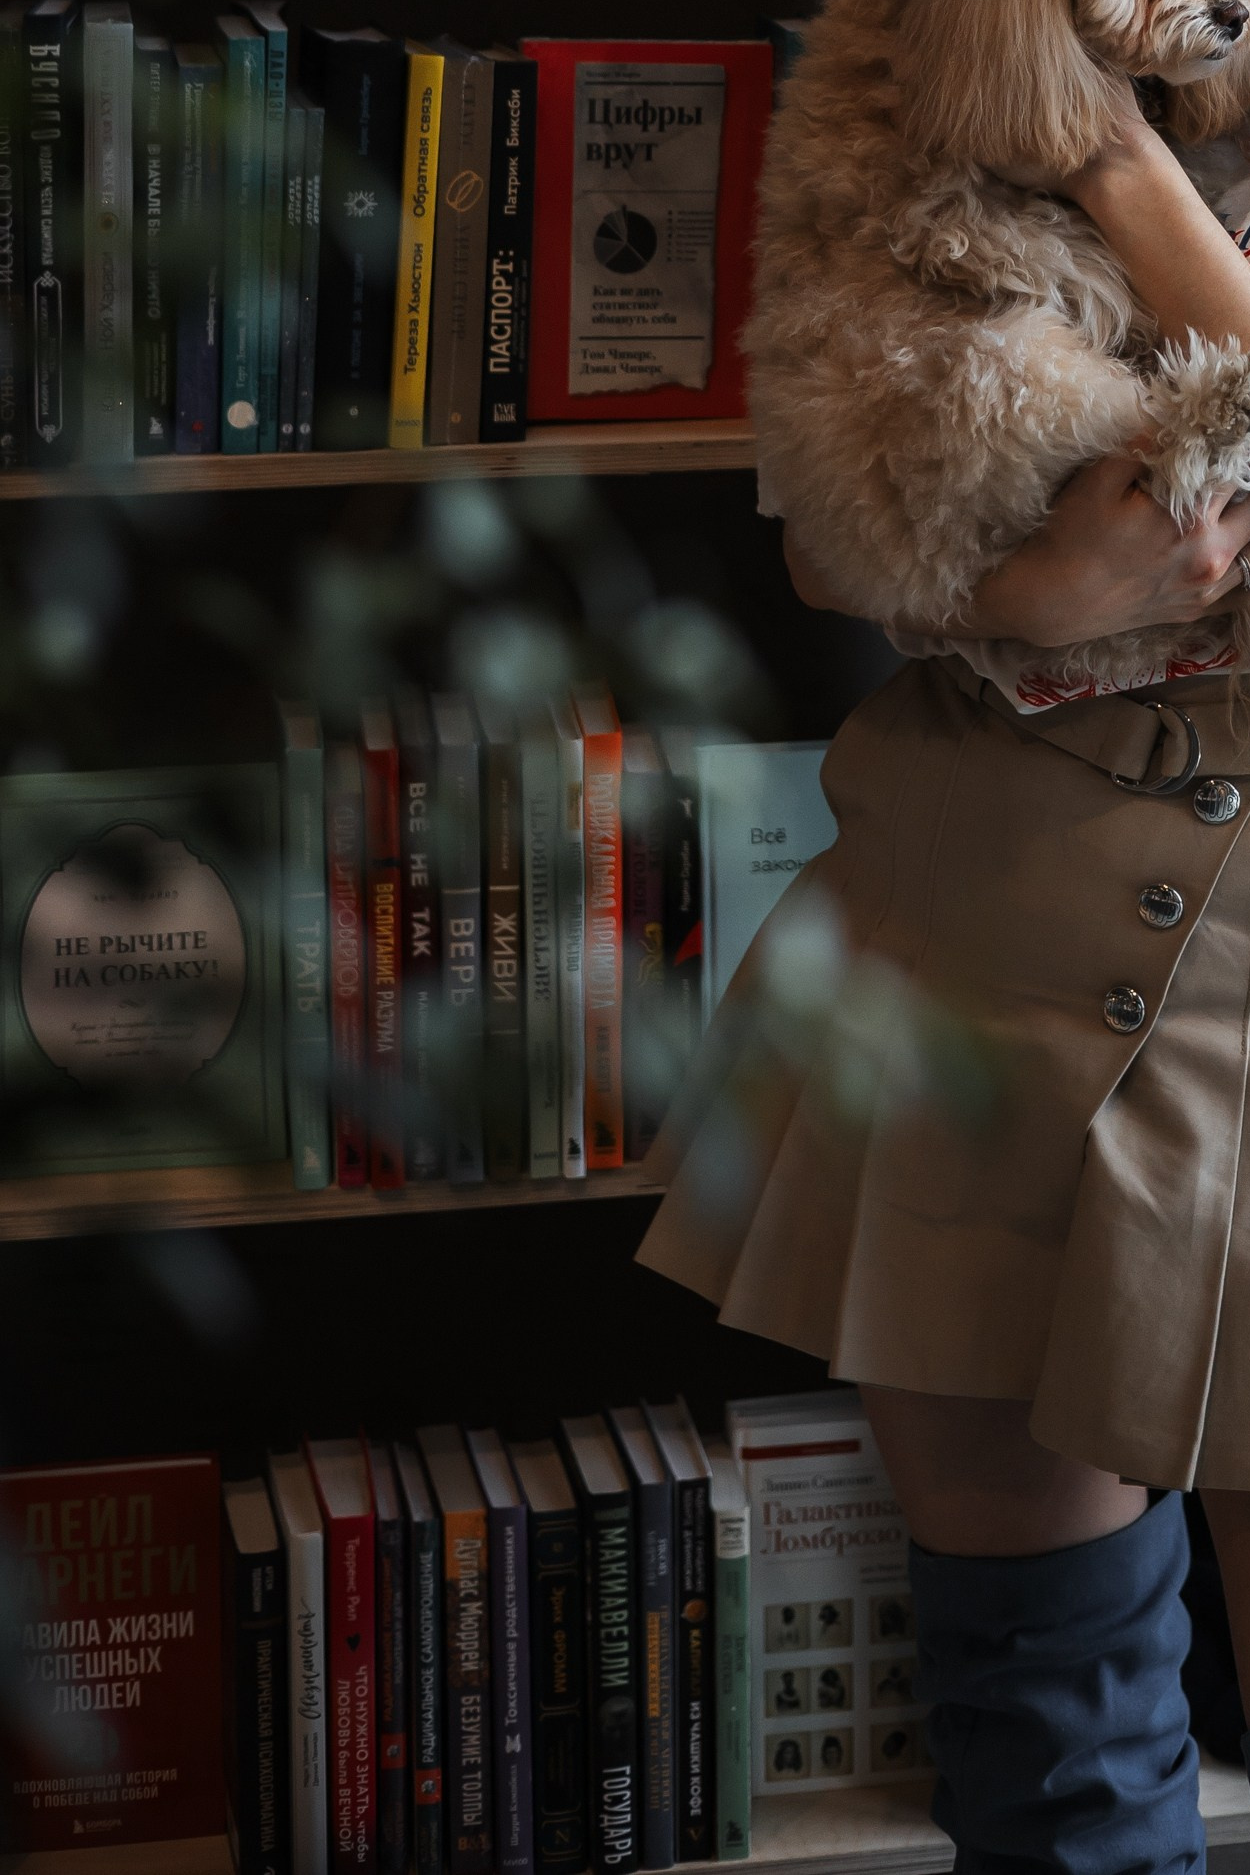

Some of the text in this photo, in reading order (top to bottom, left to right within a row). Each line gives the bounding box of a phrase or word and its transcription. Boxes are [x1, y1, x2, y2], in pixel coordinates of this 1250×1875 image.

[588, 99, 703, 133] Цифры
[147, 157, 161, 215] НАЧАЛЕ
[586, 143, 658, 170] врут
[403, 86, 433, 375] Тереза Хьюстон Обратная связь
[489, 88, 521, 374] ПАСПОРТ: Патрик Биксби
[591, 313, 677, 326] обмануть себя
[750, 827, 787, 844] Всё
[409, 852, 433, 959] НЕ ТАК
[54, 959, 219, 988] НА СОБАКУ!
[55, 931, 208, 956] НЕ РЫЧИТЕ
[375, 881, 396, 1053] ВОСПИТАНИЕ РАЗУМА
[448, 916, 476, 1007] ВЕРЬ
[492, 911, 518, 1003] ЖИВИ
[25, 1493, 155, 1555] ДЕЙЛ
[107, 1609, 196, 1645] ЖИЗНИ
[345, 1594, 360, 1622] Рил
[502, 1526, 520, 1728] Токсичные родственники
[24, 1646, 163, 1684] УСПЕШНЫХ
[418, 1551, 436, 1763] РАДИКАЛЬНОЕ САМОПРОЩЕНИЕ
[452, 1537, 485, 1826] Дуглас Мюррей БЕЗУМИЕ ТОЛПЫ
[551, 1628, 568, 1694] ФРОММ
[52, 1678, 142, 1715] ЛЮДЕЙ
[599, 1525, 633, 1865] МАКИАВЕЛЛИ ГОСУДАРЬ
[125, 1768, 178, 1785] ИСТОРИЯ
[337, 1678, 355, 1851] ЛЮБОВЬ была ВЕЧНОЙ
[353, 1664, 369, 1863] ЧТО НУЖНО ЗНАТЬ, чтобы
[688, 1701, 703, 1817] ИЗ ЧАШКИ КОФЕ
[33, 1795, 41, 1809] О
[43, 1791, 91, 1807] ПОБЕДЕ
[120, 1783, 160, 1801] СОБОЙ
